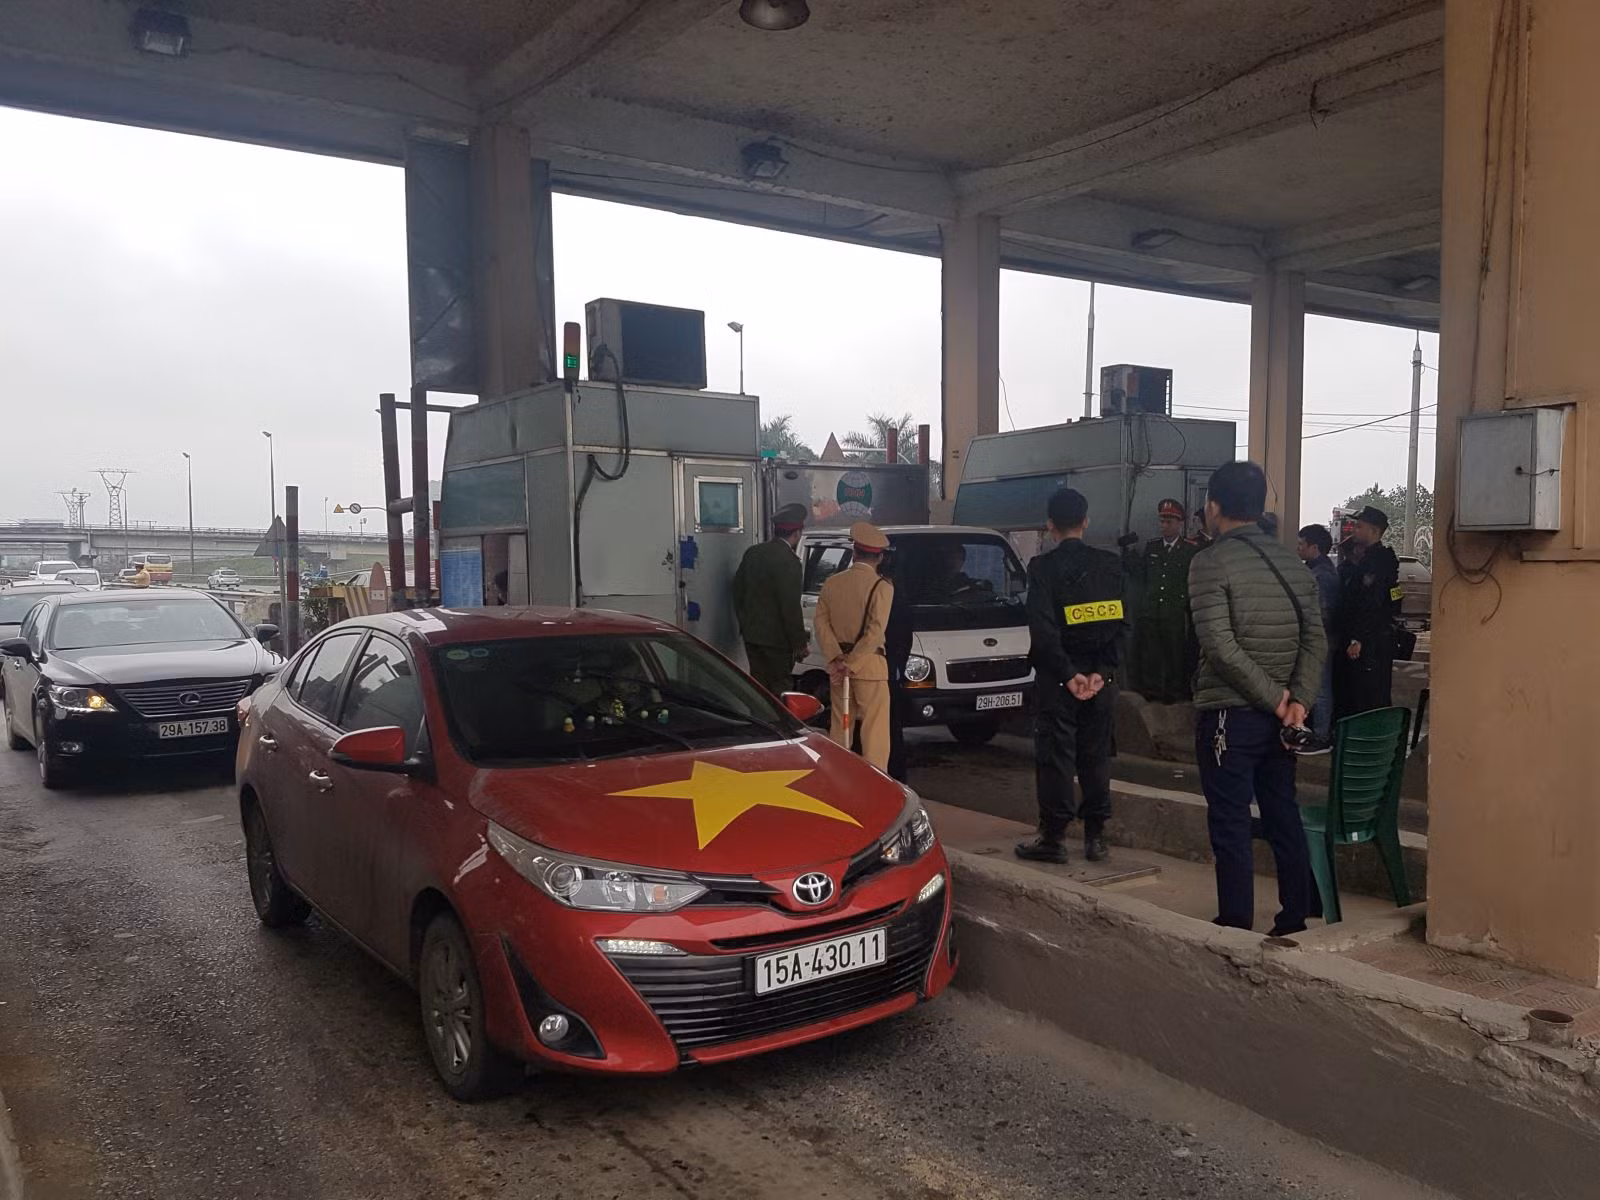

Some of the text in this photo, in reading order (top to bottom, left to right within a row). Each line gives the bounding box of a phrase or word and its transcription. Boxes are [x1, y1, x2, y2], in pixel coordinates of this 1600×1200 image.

[978, 694, 1021, 709] 29H-206.51
[160, 720, 226, 737] 29A-157.38
[763, 933, 879, 988] 15A-430.11
